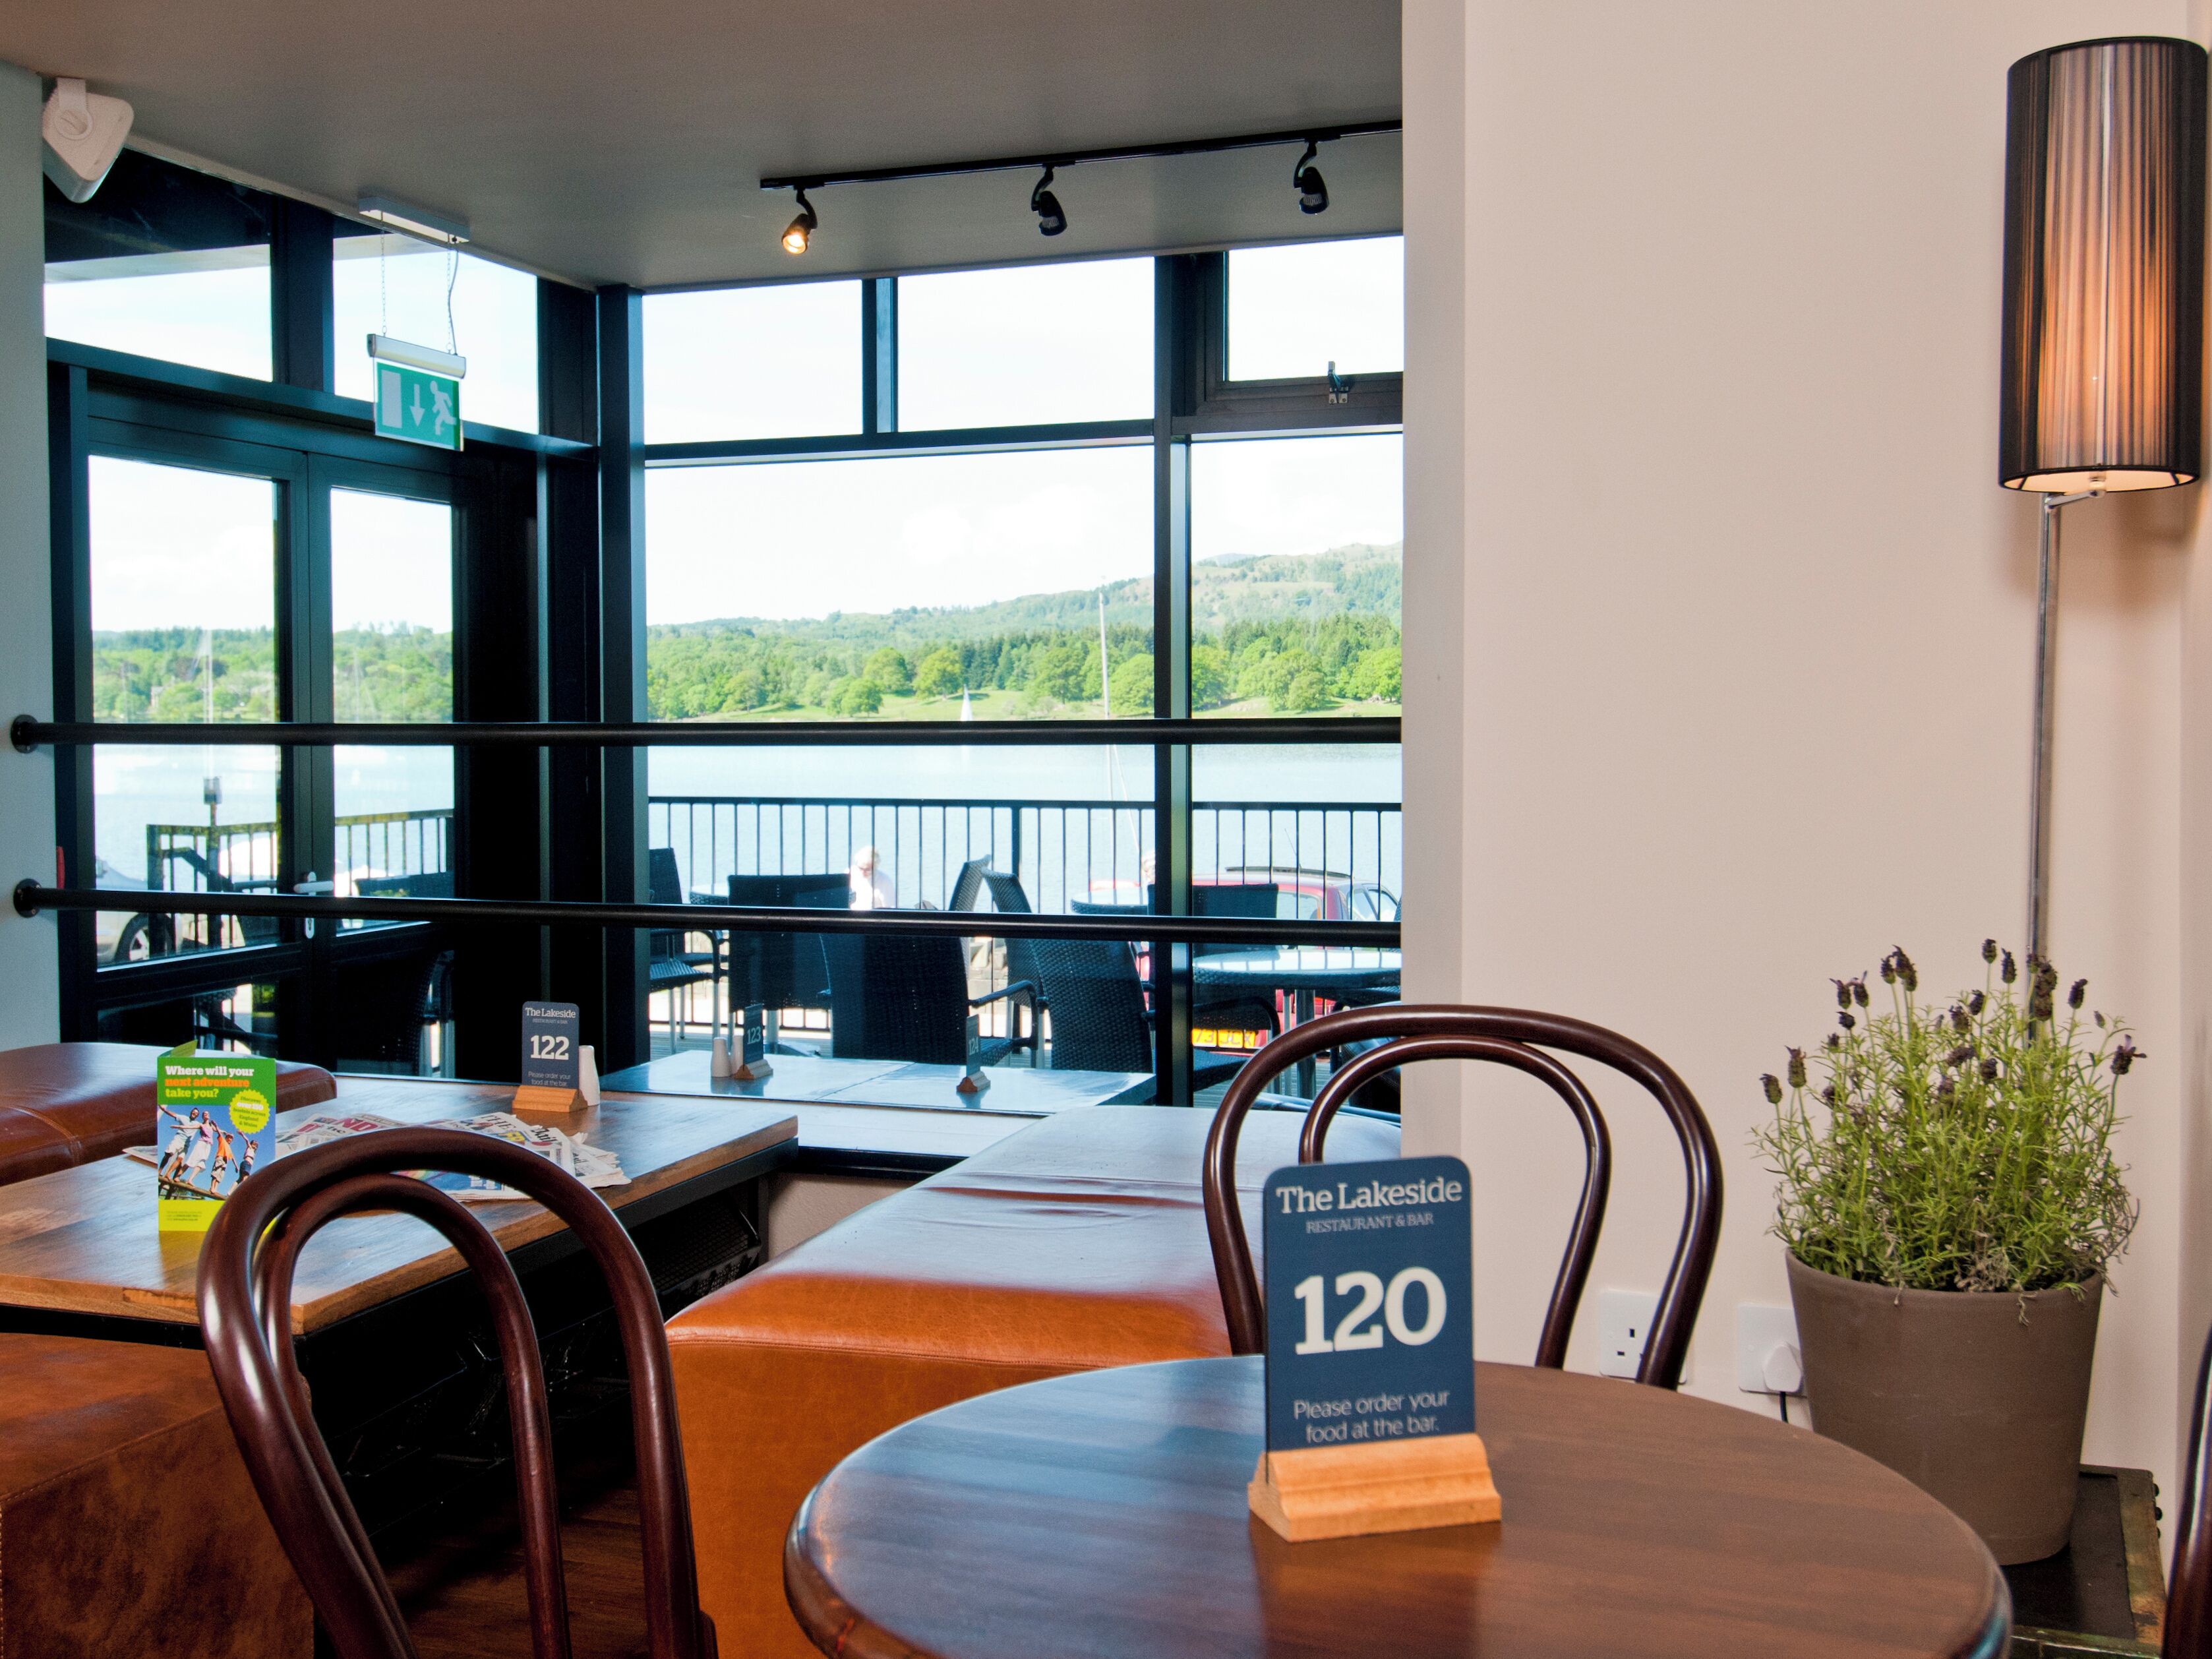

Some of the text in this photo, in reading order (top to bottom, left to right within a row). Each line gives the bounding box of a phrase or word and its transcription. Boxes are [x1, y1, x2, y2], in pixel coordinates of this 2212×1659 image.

[525, 1008, 576, 1018] The Lakeside
[747, 1026, 762, 1044] 123
[530, 1035, 570, 1060] 122
[969, 1036, 979, 1056] 124
[165, 1066, 254, 1077] Where will your
[165, 1077, 250, 1087] next adventure
[165, 1088, 219, 1099] take you?
[481, 1115, 516, 1130] THE
[1276, 1176, 1462, 1214] The Lakeside
[1305, 1213, 1434, 1234] RESTAURANT & BAR
[1294, 1265, 1448, 1355] 120
[1294, 1390, 1450, 1420] Please order your
[1305, 1415, 1439, 1443] food at the bar.
